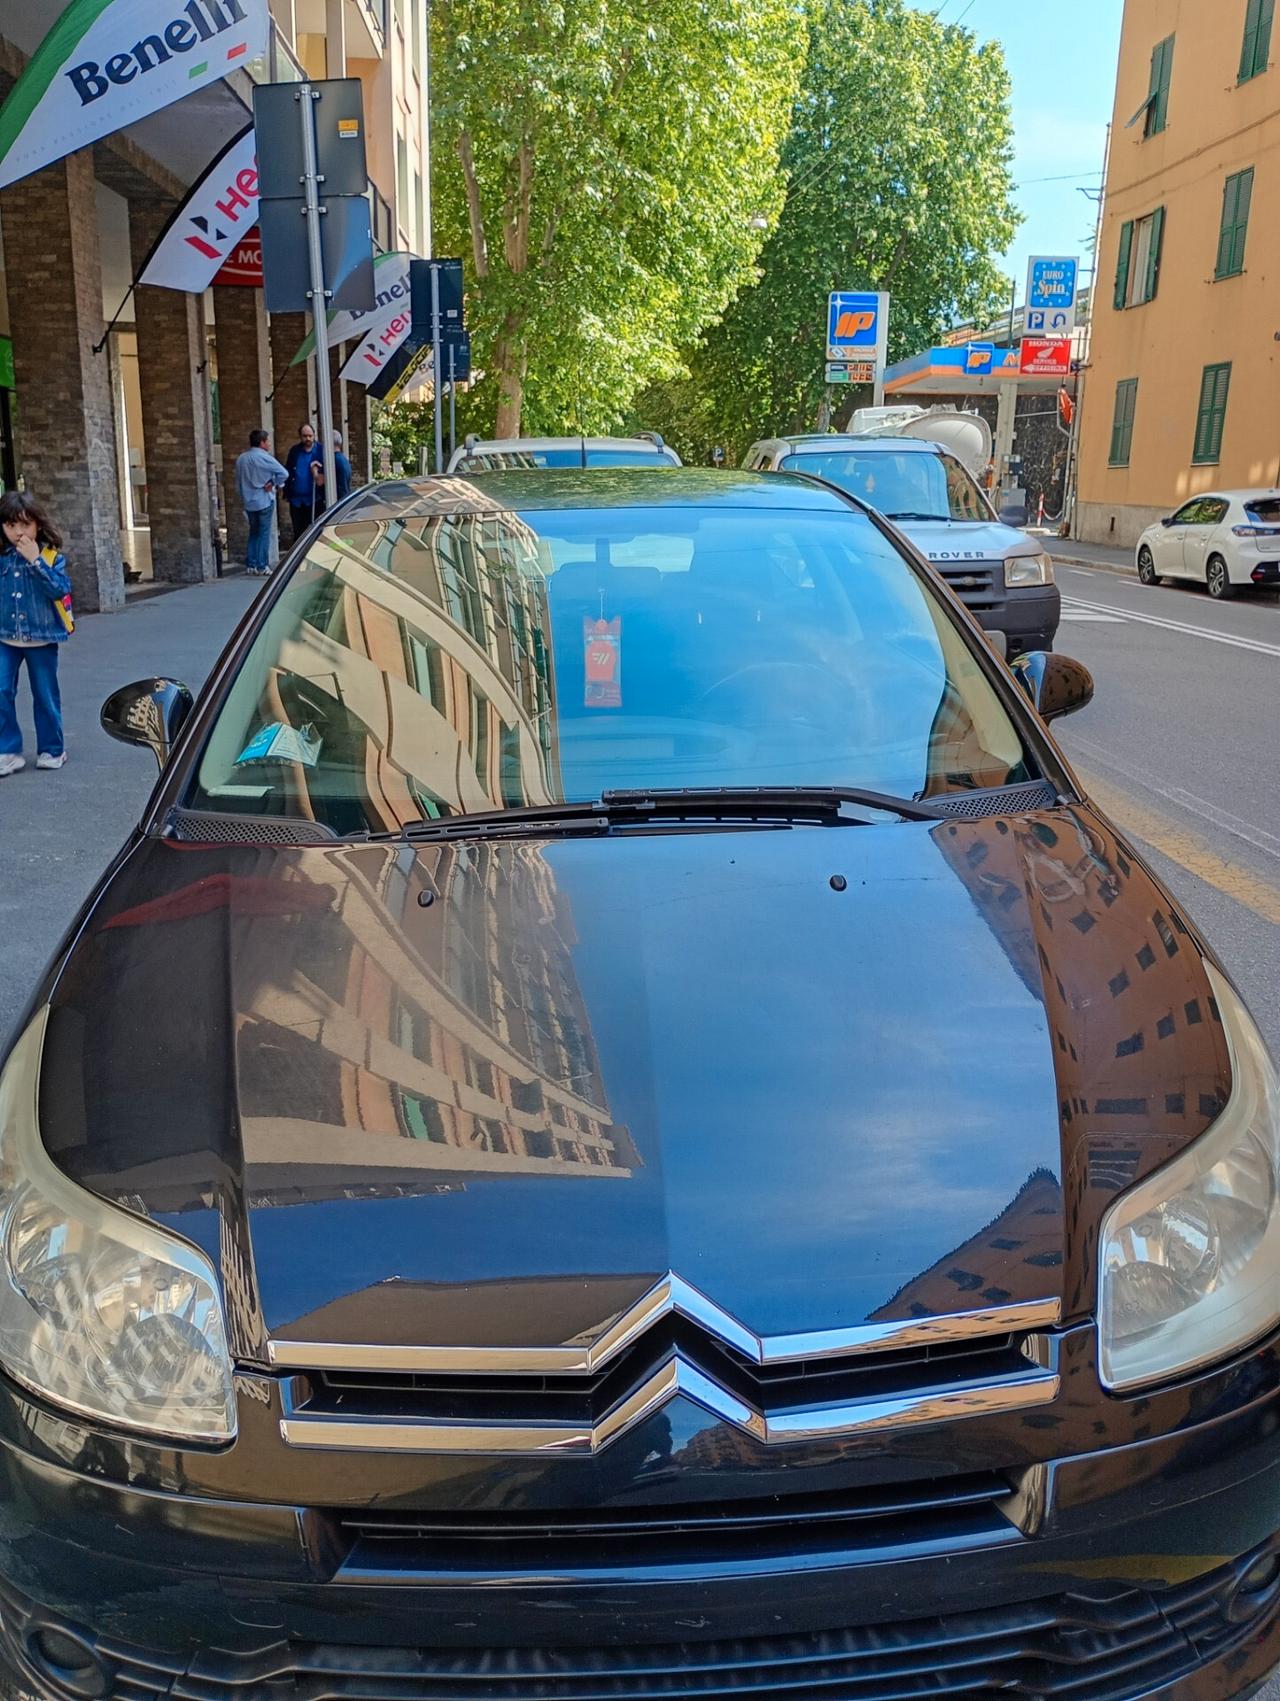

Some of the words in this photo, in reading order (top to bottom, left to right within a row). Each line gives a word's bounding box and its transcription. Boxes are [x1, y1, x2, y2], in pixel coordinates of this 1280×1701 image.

[64, 0, 248, 106] Benelli
[215, 153, 259, 222] He
[238, 250, 262, 264] MO
[1042, 270, 1064, 279] EURO
[1037, 279, 1066, 298] Spin
[834, 312, 876, 337] IP
[1031, 313, 1042, 328] P
[967, 352, 991, 368] IP
